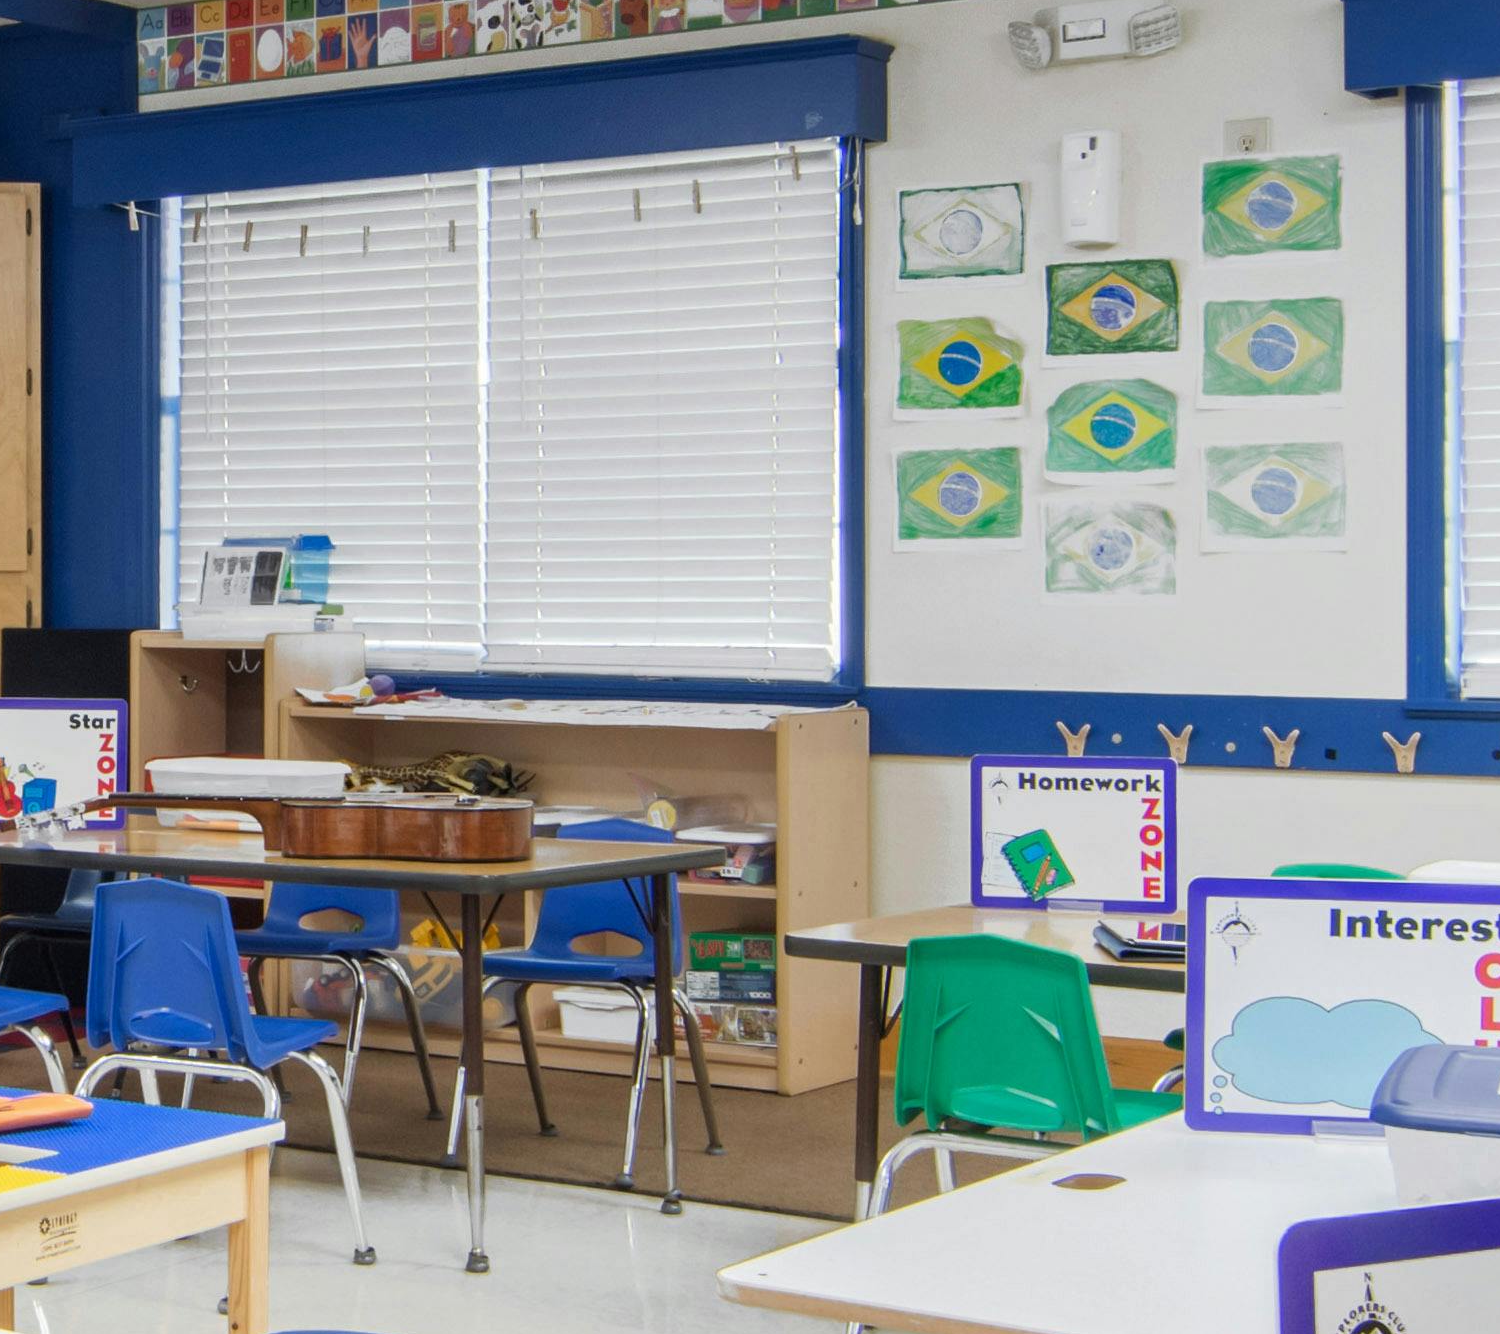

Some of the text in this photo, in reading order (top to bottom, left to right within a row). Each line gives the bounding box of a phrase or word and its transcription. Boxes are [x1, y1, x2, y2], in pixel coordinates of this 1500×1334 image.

[142, 17, 163, 33] Aa
[199, 3, 221, 25] Cc
[229, 0, 251, 21] Dd
[69, 714, 116, 730] Star
[1019, 773, 1161, 792] Homework
[1140, 798, 1163, 898] ZONE
